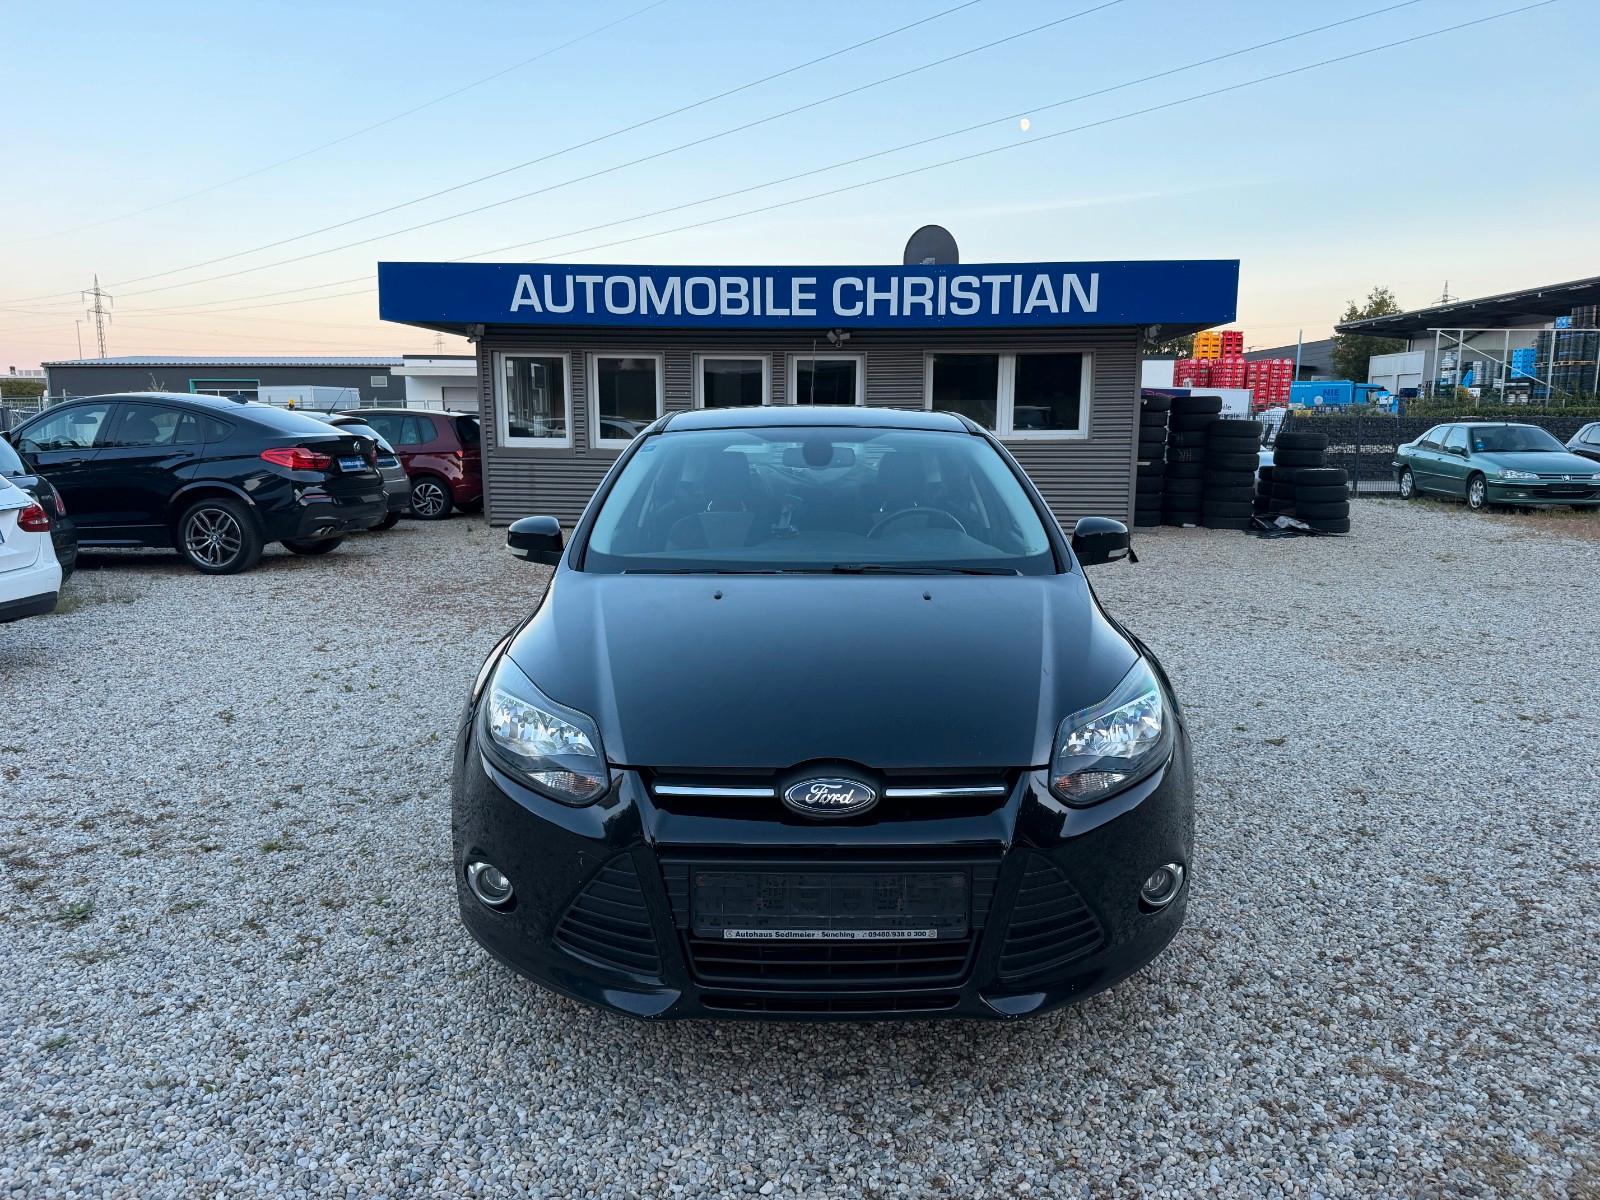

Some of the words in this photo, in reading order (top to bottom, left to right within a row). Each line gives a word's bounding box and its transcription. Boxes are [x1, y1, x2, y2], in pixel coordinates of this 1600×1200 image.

[509, 274, 817, 316] AUTOMOBILE
[832, 272, 1100, 317] CHRISTIAN
[805, 783, 855, 804] Ford
[774, 931, 816, 939] Sedlmeier
